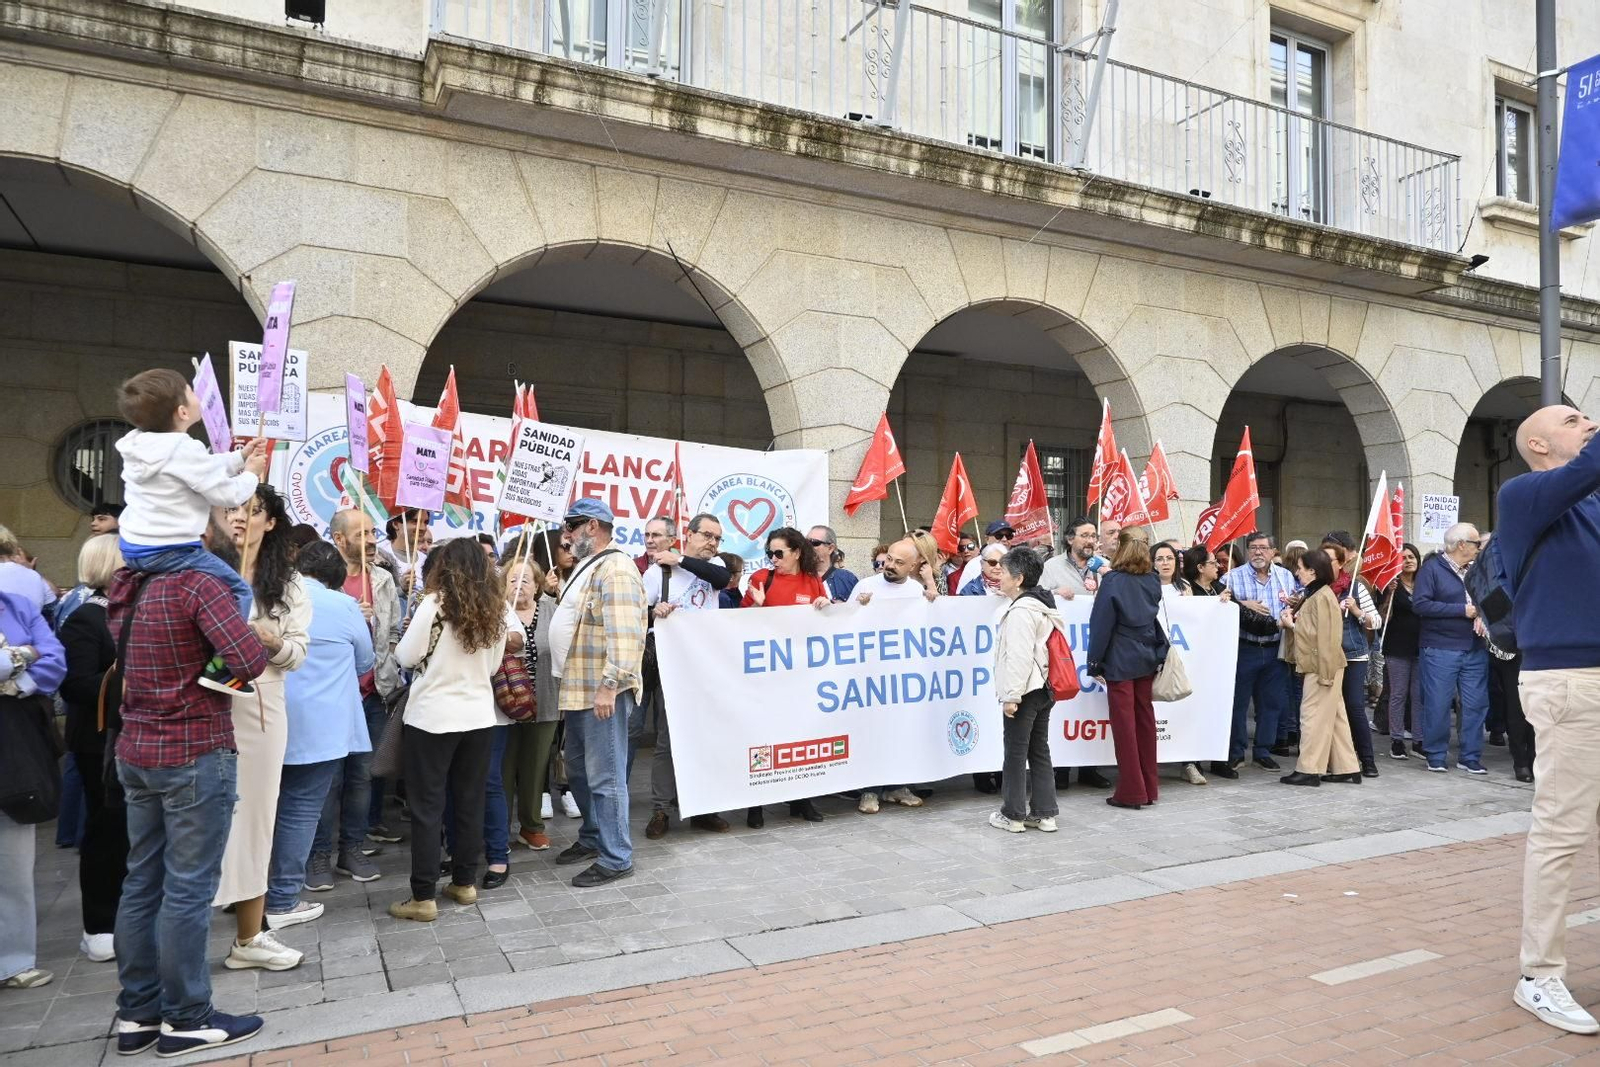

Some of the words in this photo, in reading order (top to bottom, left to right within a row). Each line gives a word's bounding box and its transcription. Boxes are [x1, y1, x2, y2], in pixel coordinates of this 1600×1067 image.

[237, 384, 257, 393] NUEST
[237, 392, 256, 400] VIDAS
[237, 417, 250, 426] SUS
[251, 418, 280, 427] NEOCIOS
[303, 429, 349, 458] MAREA
[523, 426, 576, 449] SANIDAD
[416, 446, 437, 460] MATA
[519, 439, 571, 463] PÚBLICA
[511, 467, 528, 479] VIDAS
[514, 460, 541, 473] NUESTRAS
[576, 450, 676, 483] LANCA
[509, 476, 539, 490] IMPORTAN
[708, 476, 743, 500] MAREA
[746, 477, 787, 502] BLANCA
[291, 472, 313, 522] SANIDAD
[504, 492, 517, 501] SUS
[515, 495, 542, 508] NEGOCIOS
[1424, 495, 1458, 504] SANIDAD
[743, 557, 774, 571] ELVA
[743, 638, 794, 674] EN
[806, 625, 968, 669] DEFENSA
[816, 669, 964, 713] SANIDAD
[1063, 719, 1111, 741] UGT
[777, 742, 832, 764] CCOO
